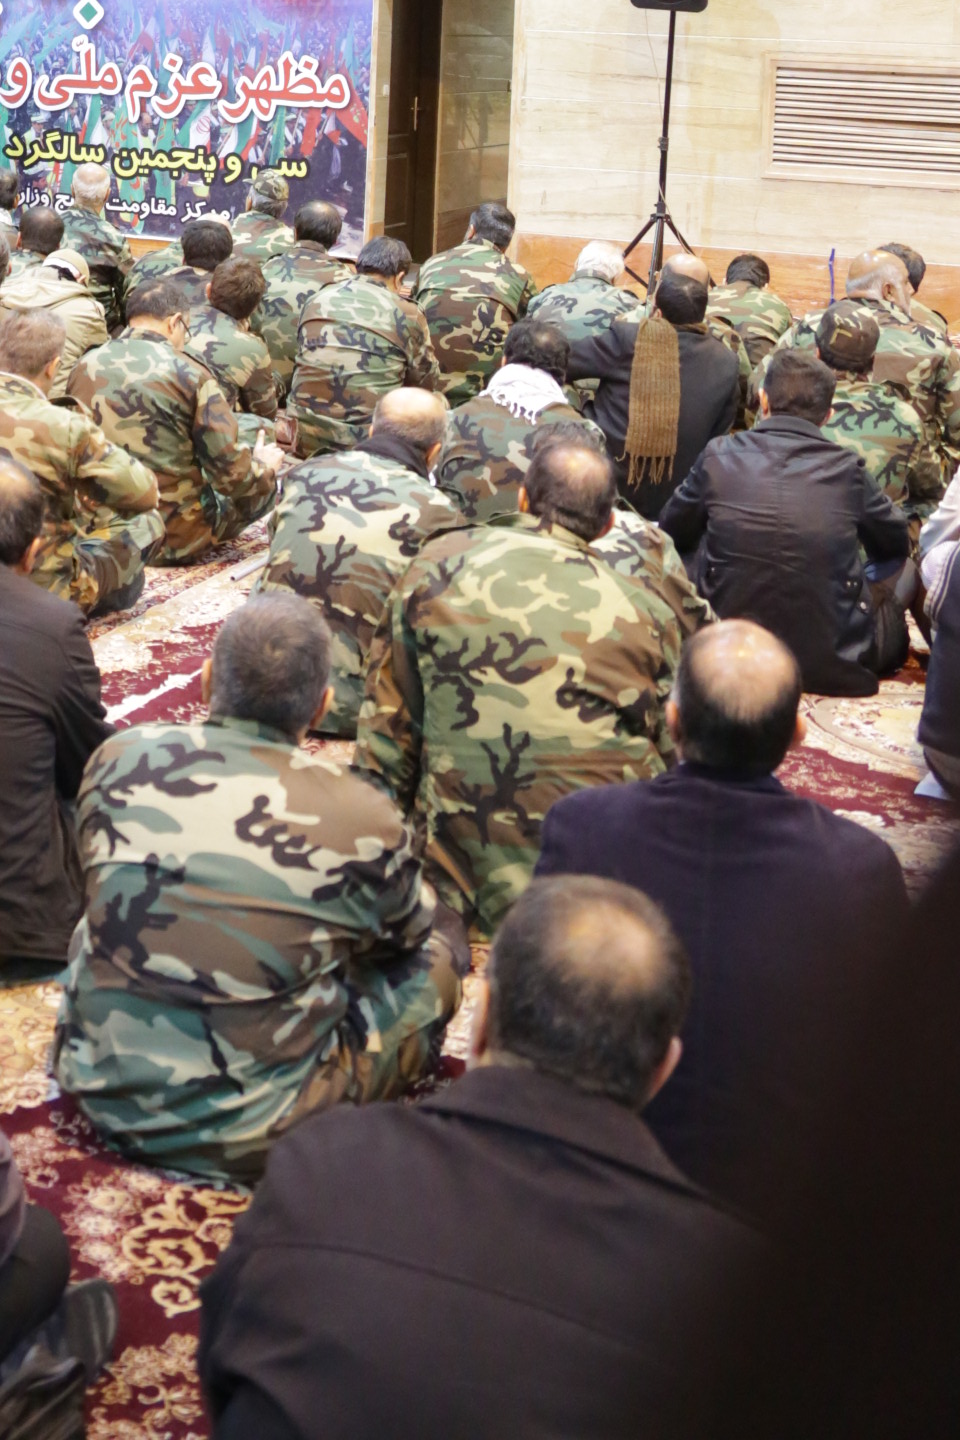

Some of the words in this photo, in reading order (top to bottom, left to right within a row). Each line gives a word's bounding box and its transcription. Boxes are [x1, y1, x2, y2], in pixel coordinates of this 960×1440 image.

[126, 53, 221, 122] عزم
[219, 52, 350, 123] مظهر
[5, 131, 105, 167] سالگرد
[114, 147, 217, 183] پنجمین
[223, 154, 242, 183] و
[105, 197, 178, 219] مقاومت
